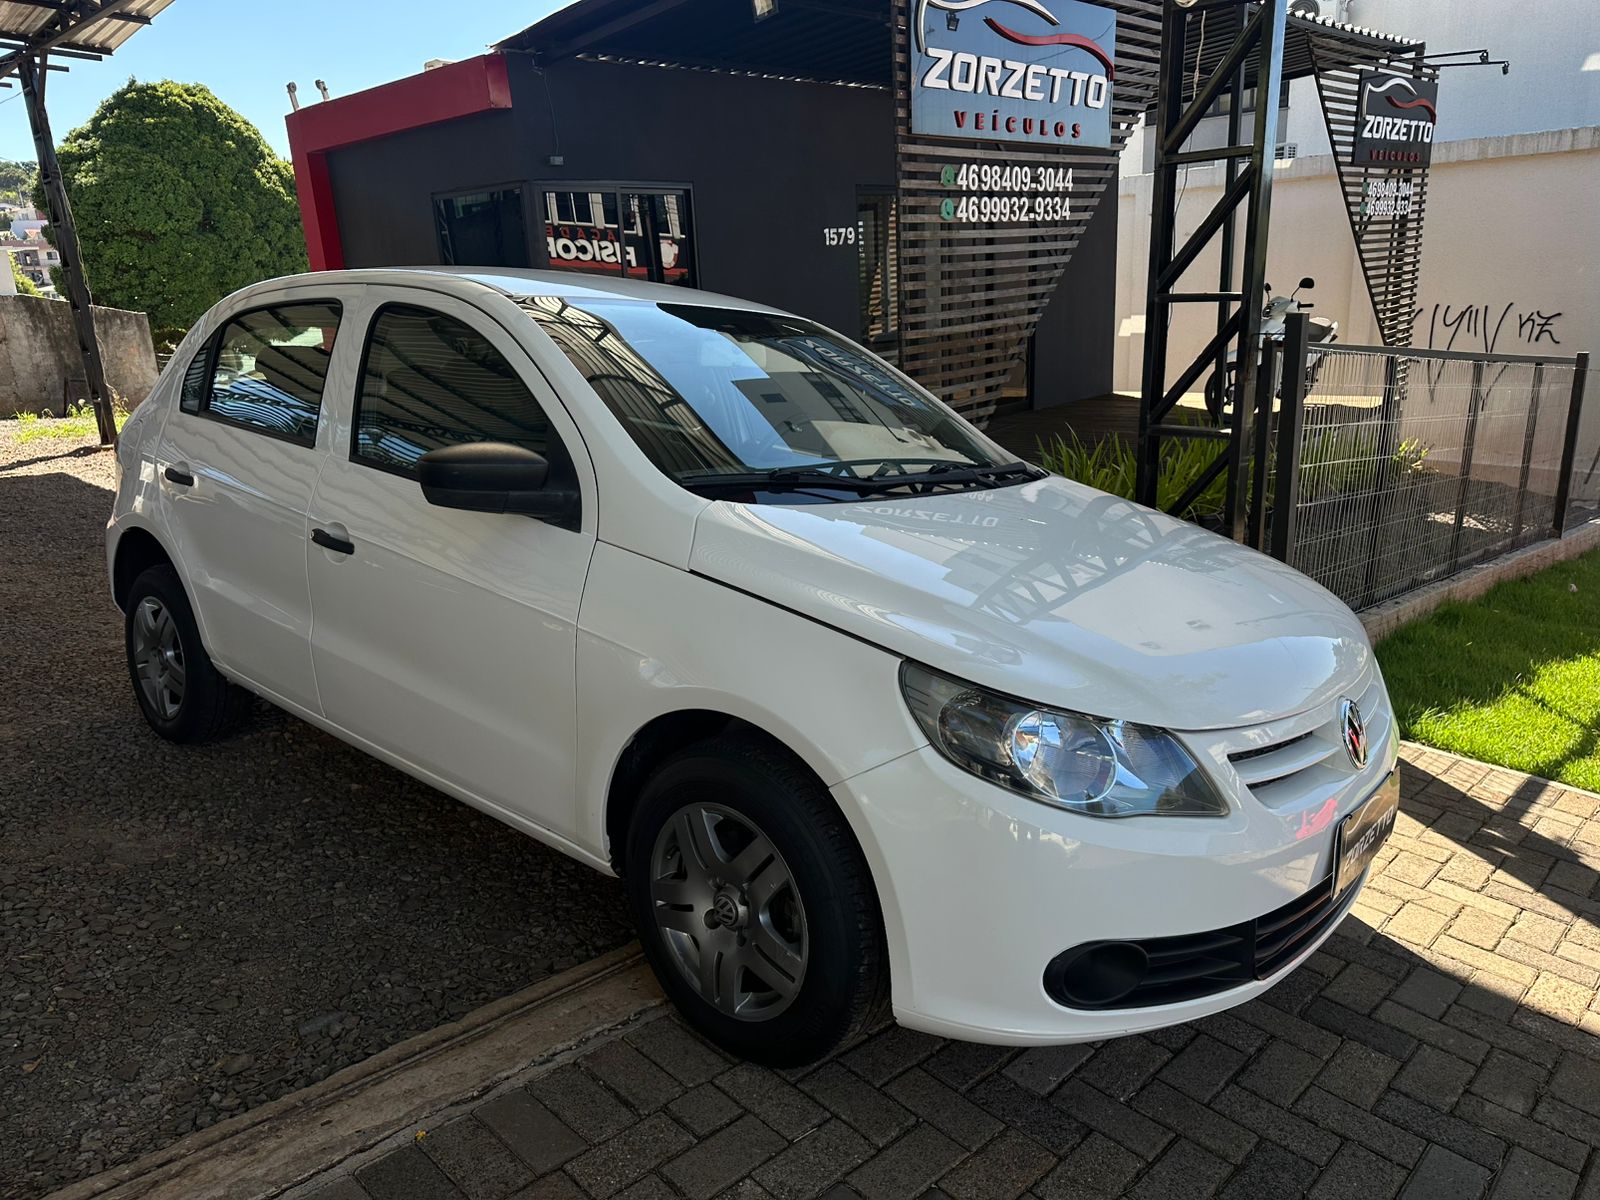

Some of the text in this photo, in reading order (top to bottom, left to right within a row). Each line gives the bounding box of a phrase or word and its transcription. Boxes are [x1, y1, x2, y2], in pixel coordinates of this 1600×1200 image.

[922, 47, 1107, 109] ZORZETTO
[953, 109, 1081, 138] VEÍCULOS
[1361, 114, 1434, 143] ZORZETTO
[823, 226, 856, 246] 1579
